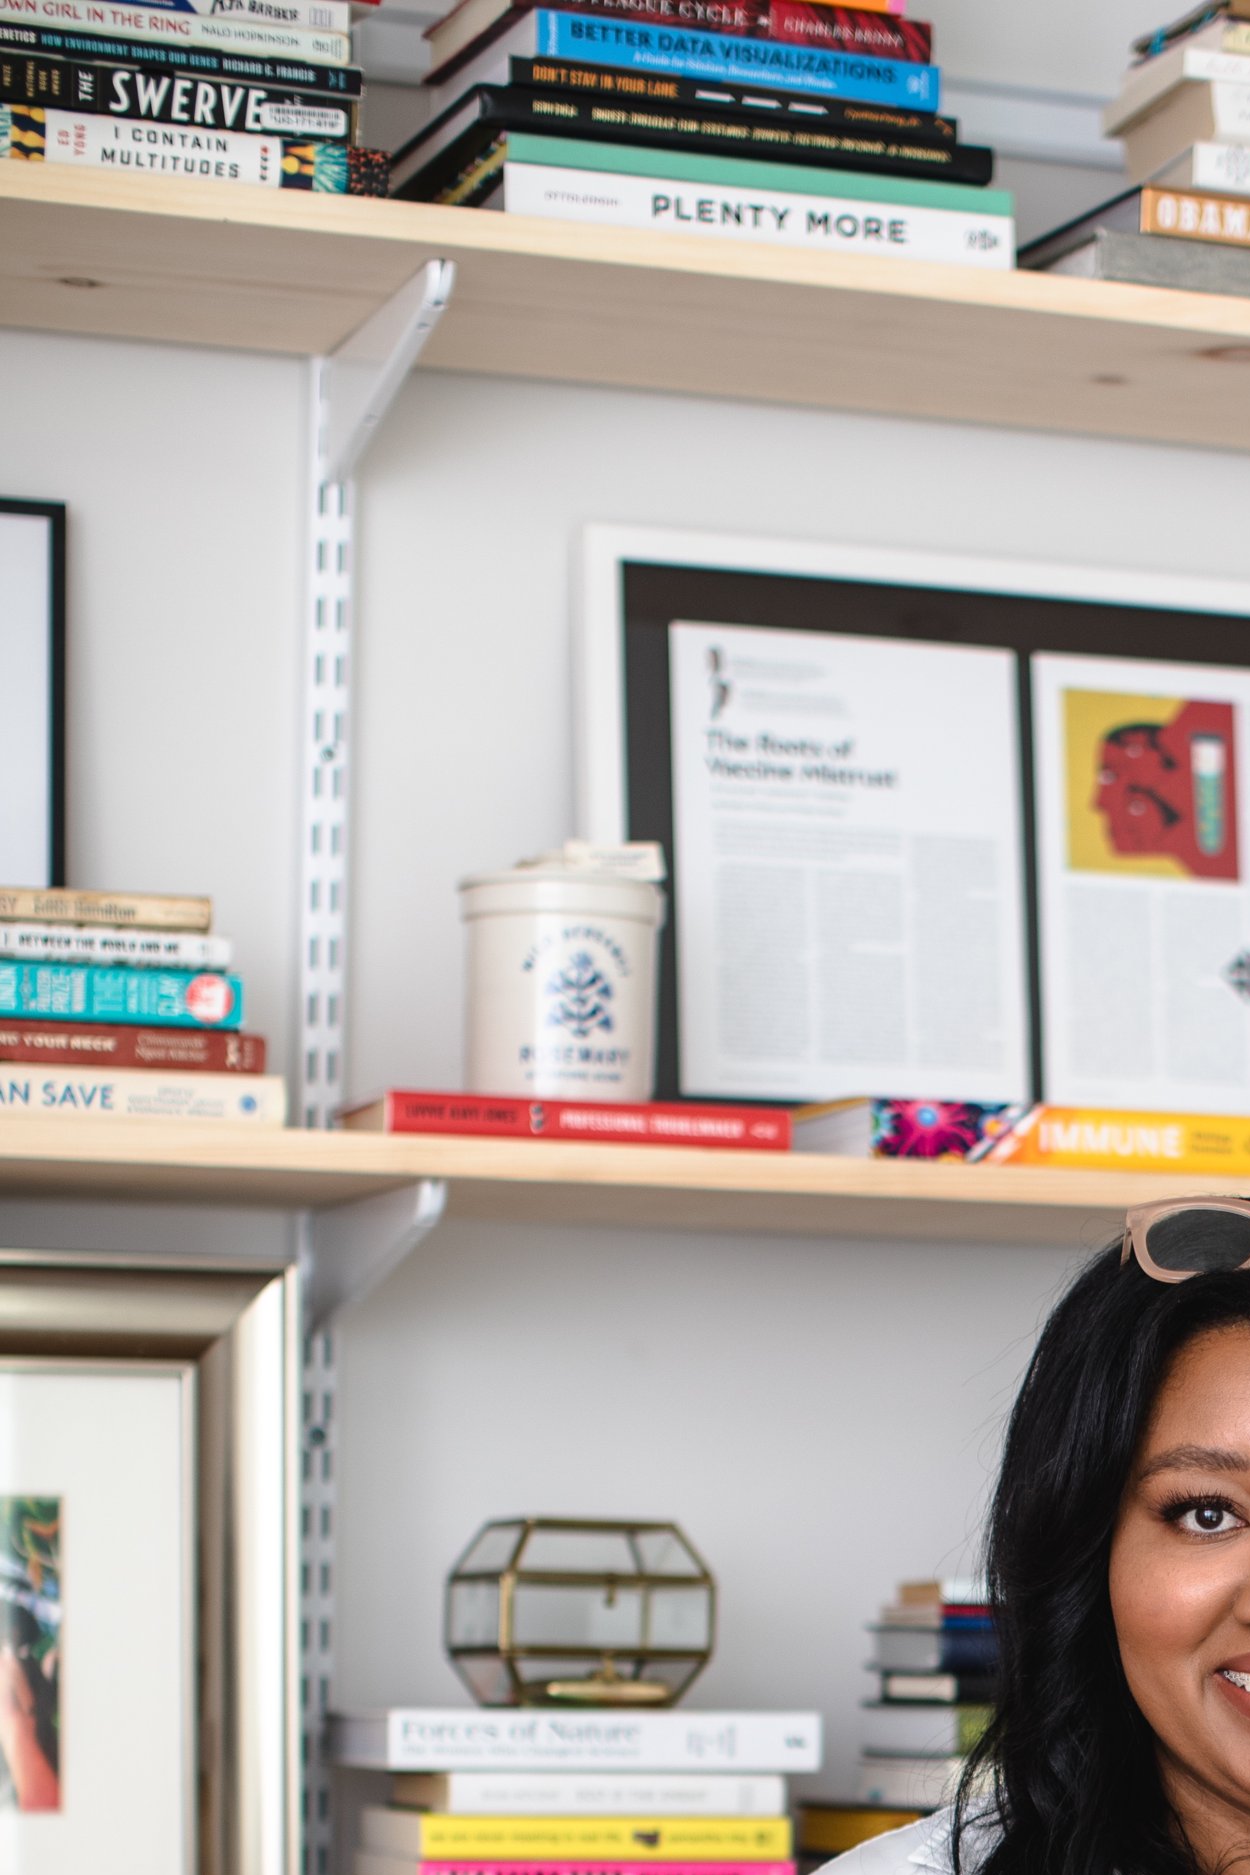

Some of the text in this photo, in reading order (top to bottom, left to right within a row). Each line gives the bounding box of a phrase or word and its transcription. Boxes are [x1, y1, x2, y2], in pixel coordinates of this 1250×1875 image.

[42, 1, 82, 20] GIRL
[86, 7, 105, 24] IN
[110, 9, 145, 30] THE
[148, 15, 193, 37] RING
[678, 1, 751, 27] CYCLE
[201, 22, 301, 48] NALO HOPKINSON
[570, 18, 653, 50] BETTER
[657, 31, 715, 58] DATA
[718, 41, 897, 84] VISUALIZATIONS
[41, 33, 62, 47] HOW
[64, 36, 129, 57] ENVIRONMENT
[131, 44, 167, 63] SHAPES
[168, 49, 188, 64] OUR
[221, 57, 264, 77] RICHARD
[275, 65, 318, 84] FRANCIS
[78, 69, 95, 102] THE
[532, 63, 567, 83] DON'T
[569, 68, 598, 87] STAY
[600, 73, 615, 90] IN
[616, 75, 647, 95] YOUR
[109, 69, 268, 131] SWERVE
[57, 128, 70, 147] ED
[73, 122, 87, 157] YONG
[114, 124, 229, 153] I CONTAIN
[100, 146, 241, 179] MULTITUDES
[650, 192, 910, 245] PLENTY MORE
[705, 729, 857, 760] The Roots of
[704, 756, 899, 790] Vaccine Mistrust
[73, 897, 138, 921] Hamilton
[19, 932, 72, 948] BETWEEN
[75, 936, 96, 950] THE
[100, 936, 137, 951] WORLD
[23, 1032, 69, 1050] YOUR
[70, 1034, 118, 1053] NECK
[41, 1081, 115, 1110] SAVE
[1037, 1118, 1184, 1159] IMMUNE
[402, 1718, 642, 1745] Forces of Nature
